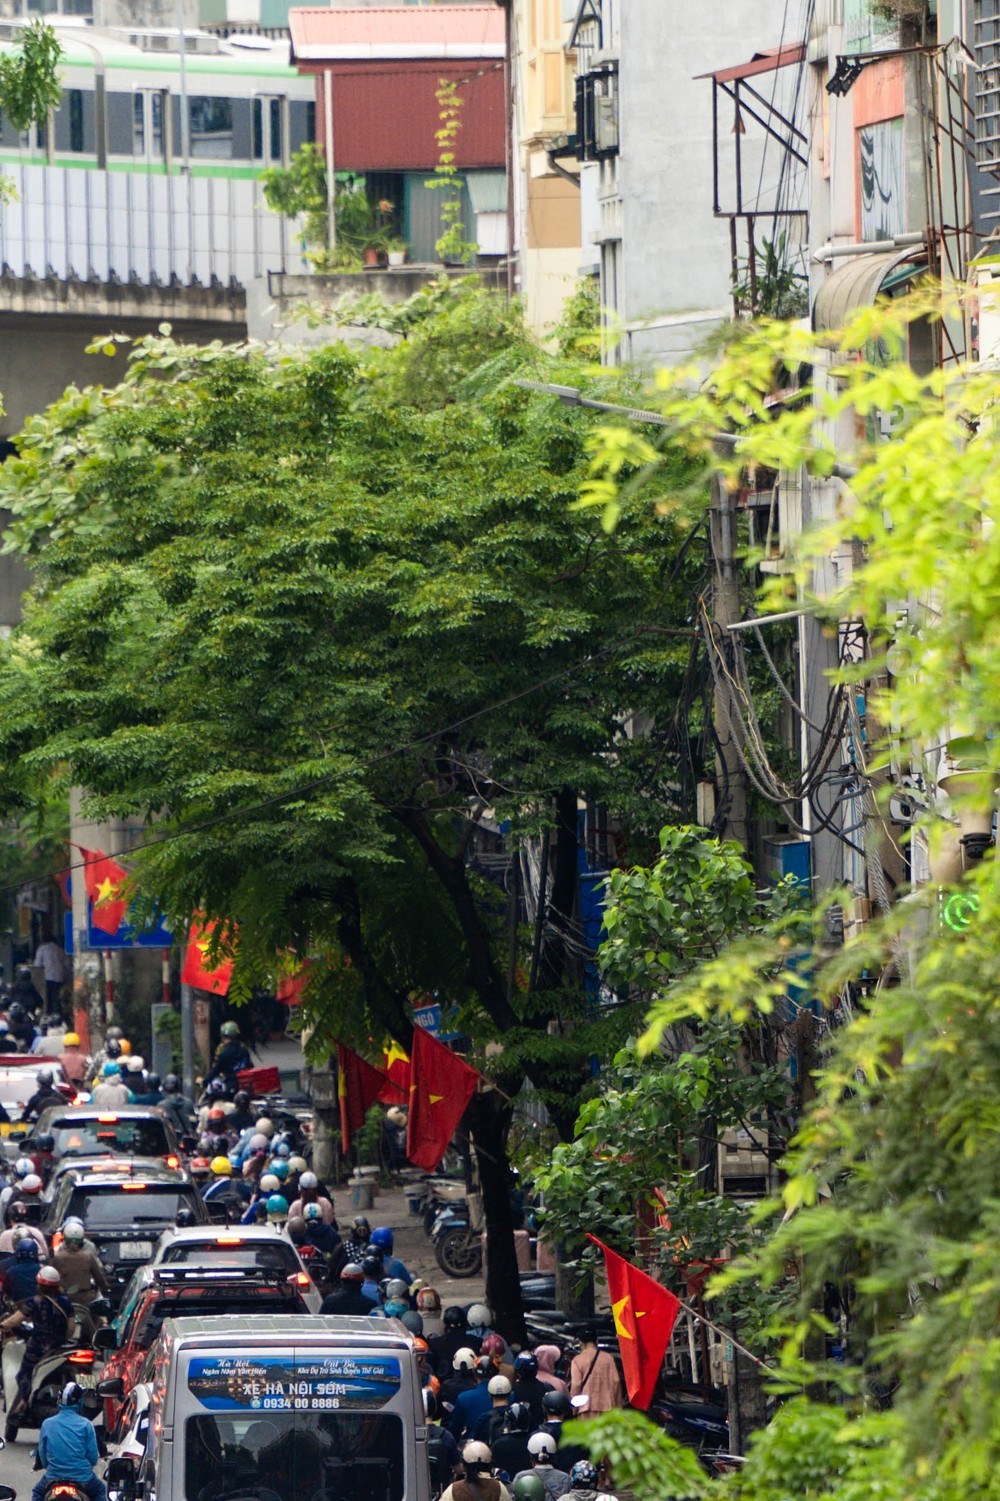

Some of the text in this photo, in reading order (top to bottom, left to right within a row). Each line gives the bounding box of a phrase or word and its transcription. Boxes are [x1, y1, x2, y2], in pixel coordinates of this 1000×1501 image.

[243, 1380, 346, 1398] XE HÀ NỘI SỚM
[264, 1398, 340, 1409] 0934 00 8886
